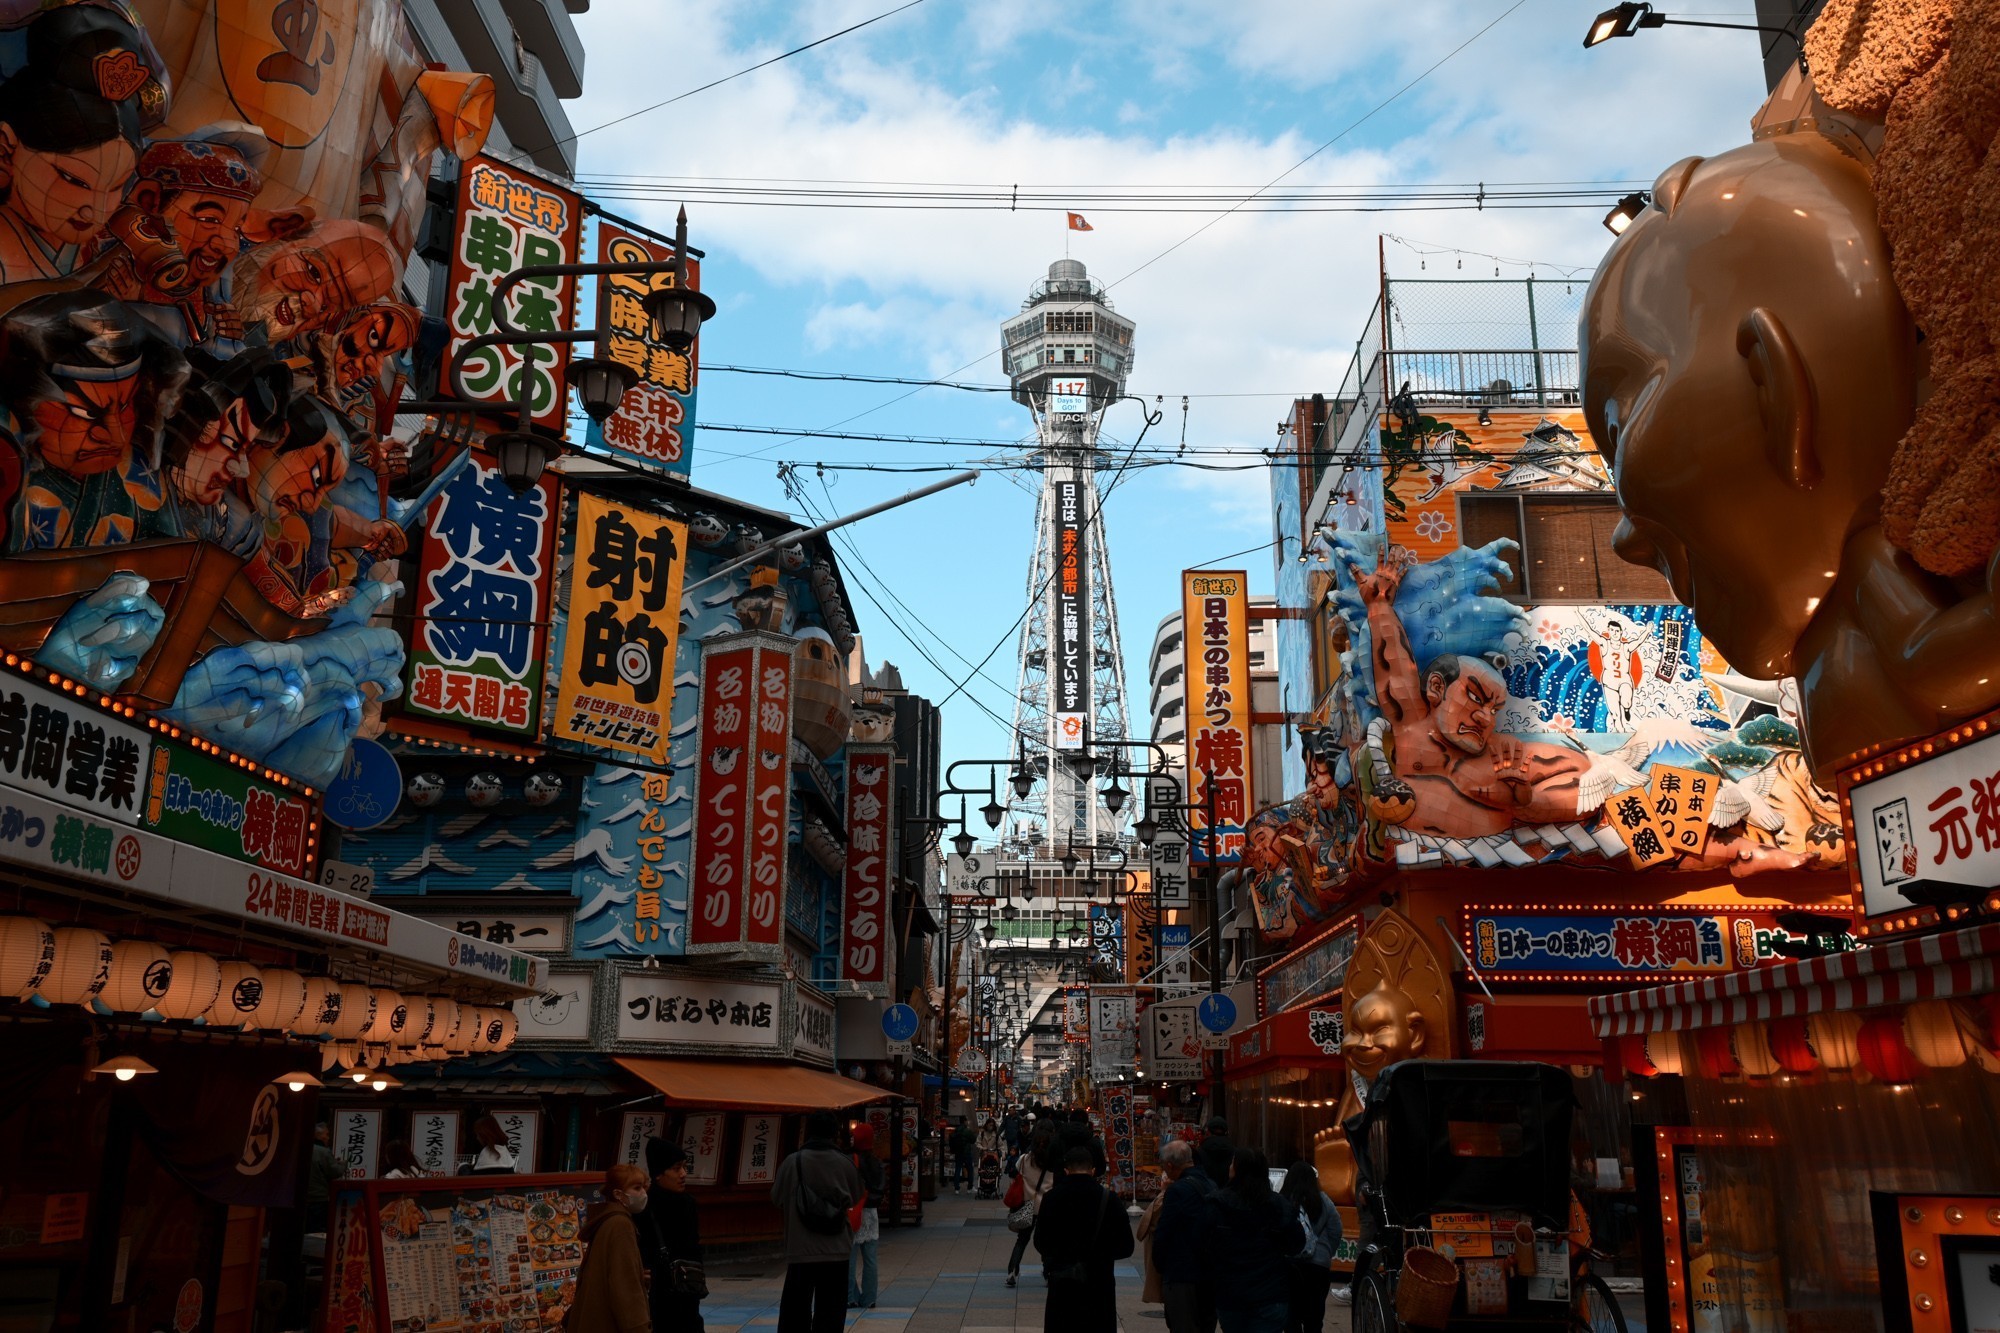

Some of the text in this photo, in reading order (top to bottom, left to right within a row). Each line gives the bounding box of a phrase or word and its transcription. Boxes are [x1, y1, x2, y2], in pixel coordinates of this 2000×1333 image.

[474, 169, 567, 234] 新世界
[458, 215, 513, 393] 串かつ
[507, 233, 561, 412] 日本一の
[1056, 382, 1085, 396] 117
[604, 415, 682, 460] 無休
[428, 462, 545, 676] 横綱
[1062, 484, 1079, 709] 日立は「未来の都市」に協賛しています
[1193, 578, 1237, 596] 新世界
[579, 510, 678, 704] 射的
[1203, 598, 1232, 726] 日本一の串かつ
[1660, 622, 1680, 677] 開運招福
[413, 664, 531, 727] 通天閣店
[574, 695, 661, 727] 新世界遊技場
[0, 690, 140, 812] 時間営業
[570, 713, 660, 749] チャンピオン
[148, 748, 169, 824] 新世界
[165, 774, 242, 830] 日本一の串かつ
[702, 666, 743, 927] 名物 てっちり
[752, 666, 786, 928] 名物 てっちり
[1195, 729, 1245, 828] 横綱
[1654, 773, 1681, 839] 串かつ
[0, 805, 114, 875] かつ 横綱
[242, 788, 304, 869] 横綱
[1617, 794, 1664, 863] 横綱
[1680, 778, 1707, 848] 日本一の
[245, 873, 388, 945] 24時間営業 年中無休
[848, 794, 881, 974] 珍味てっちり
[455, 920, 549, 944] 日本一
[460, 944, 528, 984] 日本一の串かつ 横綱
[1478, 917, 1724, 967] 新世界 日本一の串かつ 横綱 名門
[1736, 920, 1756, 966] 新世界
[88, 943, 113, 994] 一串入魂
[319, 991, 342, 1026] 横綱
[627, 995, 773, 1030] づぼらや本店
[1311, 1020, 1344, 1044] 横
[700, 1117, 718, 1156] おみやげ
